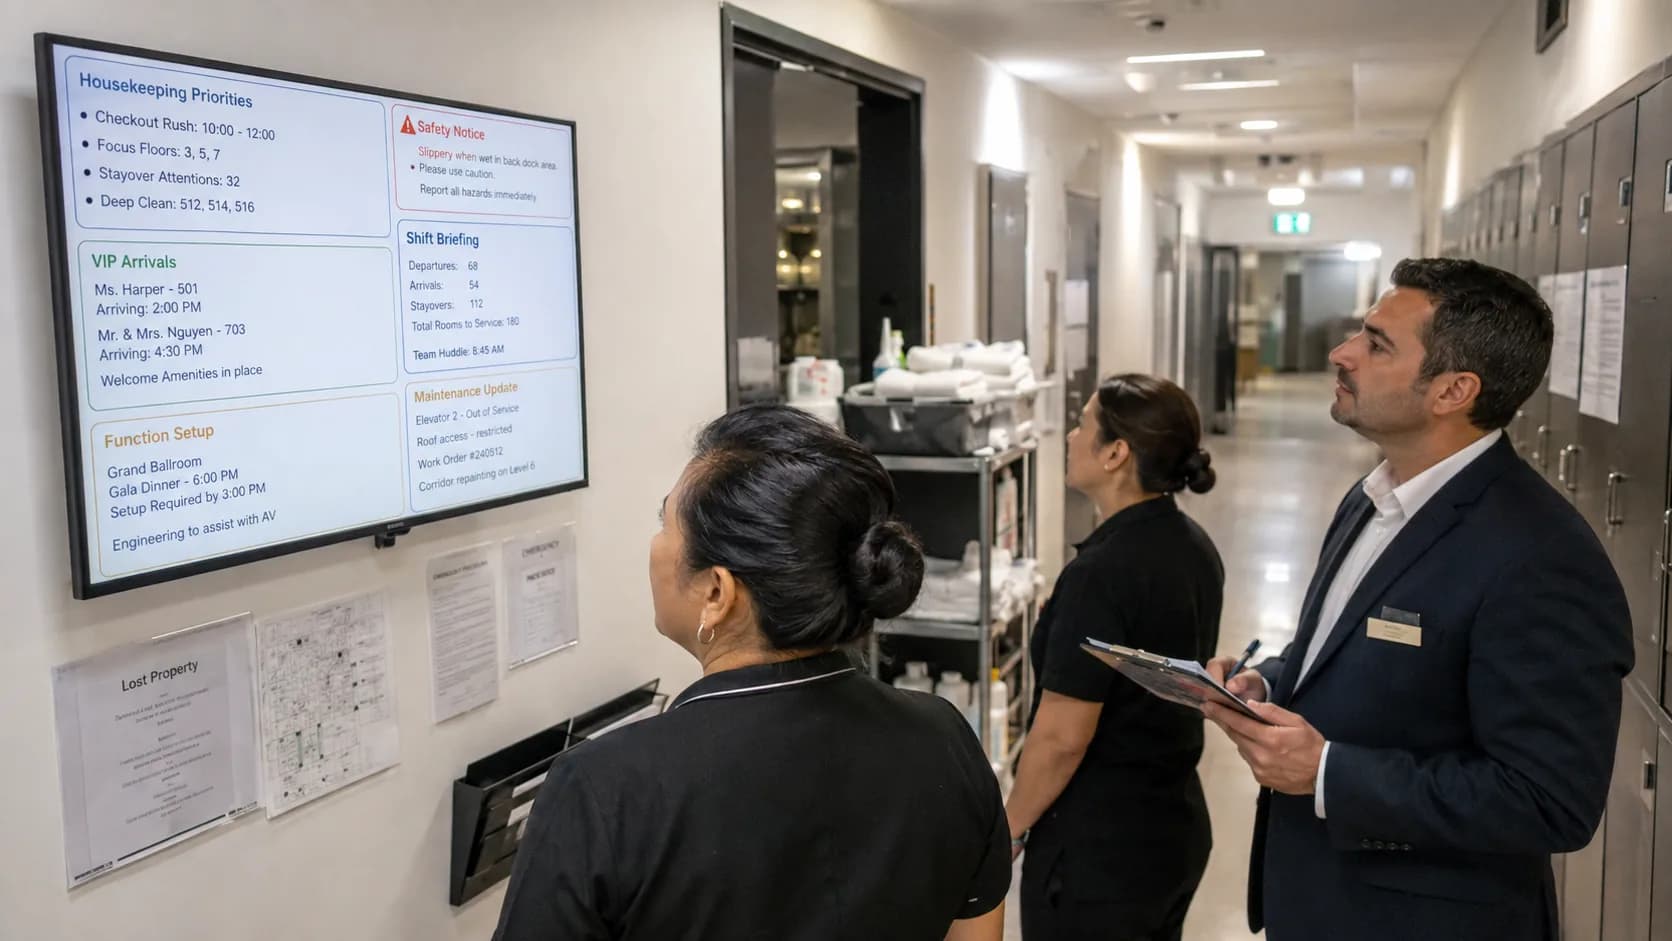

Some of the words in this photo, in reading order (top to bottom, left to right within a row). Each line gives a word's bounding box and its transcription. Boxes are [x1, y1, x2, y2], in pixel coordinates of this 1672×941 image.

[80, 72, 187, 101] Housekeeping
[191, 88, 253, 108] Priorities
[96, 110, 159, 129] Checkout
[163, 118, 198, 133] Rush:
[202, 123, 234, 136] 10:00
[247, 127, 275, 141] 12:00
[418, 121, 450, 138] Safety
[454, 127, 485, 140] Notice
[97, 139, 136, 155] Focus
[140, 142, 181, 157] Floors:
[184, 148, 195, 162] 3,
[199, 149, 210, 162] 5,
[214, 149, 220, 160] 7
[418, 146, 452, 160] Slippery
[456, 152, 476, 161] when
[479, 154, 493, 163] wet
[495, 155, 501, 164] in
[503, 157, 520, 167] back
[523, 159, 539, 168] dock
[99, 167, 154, 183] Stayover
[159, 170, 222, 186] Attentions:
[227, 176, 240, 187] 32
[420, 163, 446, 175] Please
[449, 168, 463, 176] use
[465, 169, 495, 179] caution.
[420, 184, 448, 196] Report
[450, 187, 459, 196] all
[462, 187, 493, 198] hazards
[101, 195, 134, 209] Deep
[138, 196, 176, 210] Clean:
[180, 198, 205, 212] 512,
[208, 200, 232, 213] 514,
[235, 201, 255, 212] 516
[407, 231, 434, 244] Shift
[437, 233, 479, 248] Briefing
[92, 254, 117, 269] VIP
[121, 255, 176, 269] Arrivals
[409, 260, 458, 272] Departures:
[468, 262, 478, 270] 68
[95, 284, 118, 296] Ms.
[122, 284, 165, 298] Harper
[178, 283, 198, 295] 501
[410, 280, 443, 290] Arrivals:
[469, 280, 479, 289] 54
[96, 303, 149, 317] Arriving:
[153, 302, 178, 314] 2:00
[183, 301, 201, 313] PM
[410, 301, 454, 312] Stayovers:
[471, 299, 483, 308] 112
[99, 329, 119, 341] Mr.
[123, 329, 132, 340] &
[136, 328, 163, 340] Mrs.
[168, 326, 213, 340] Nguyen
[225, 324, 245, 335] 703
[412, 321, 432, 331] Total
[435, 319, 462, 330] Rooms
[465, 319, 472, 328] to
[475, 318, 504, 328] Service:
[507, 317, 519, 326] 180
[100, 348, 151, 363] Arriving:
[155, 345, 181, 358] 4:30
[185, 344, 203, 356] PM
[413, 350, 436, 360] Team
[491, 345, 504, 354] AM
[101, 372, 158, 387] Welcome
[162, 369, 218, 383] Amenities
[222, 368, 231, 378] in
[235, 365, 263, 380] place
[415, 385, 481, 403] Maintenance
[484, 383, 518, 396] Update
[416, 413, 450, 425] Elevator
[453, 411, 458, 420] 2
[466, 409, 481, 419] Out
[483, 407, 490, 416] of
[492, 404, 519, 415] Service
[104, 429, 169, 448] Function
[174, 425, 214, 442] Setup
[417, 435, 437, 447] Roof
[440, 432, 468, 444] access
[476, 425, 512, 439] restricted
[107, 463, 146, 479] Grand
[150, 457, 202, 473] Ballroom
[418, 457, 440, 469] Work
[443, 453, 466, 465] Order
[109, 485, 137, 498] Gala
[141, 478, 180, 494] Dinner
[193, 472, 218, 486] 6:00
[221, 469, 238, 481] PM
[419, 477, 453, 491] Corridor
[456, 469, 497, 484] repainting
[498, 468, 508, 477] on
[510, 463, 529, 474] Level
[530, 462, 535, 470] 6
[110, 502, 147, 519] Setup
[150, 493, 202, 513] Required
[206, 492, 219, 505] by
[222, 486, 245, 500] 3:00
[249, 483, 266, 495] PM
[113, 527, 185, 552] Engineering
[189, 525, 199, 536] to
[203, 519, 234, 533] assist
[237, 513, 259, 528] with
[262, 510, 276, 522] AV
[121, 674, 147, 692] Lost
[150, 659, 199, 683] Property
